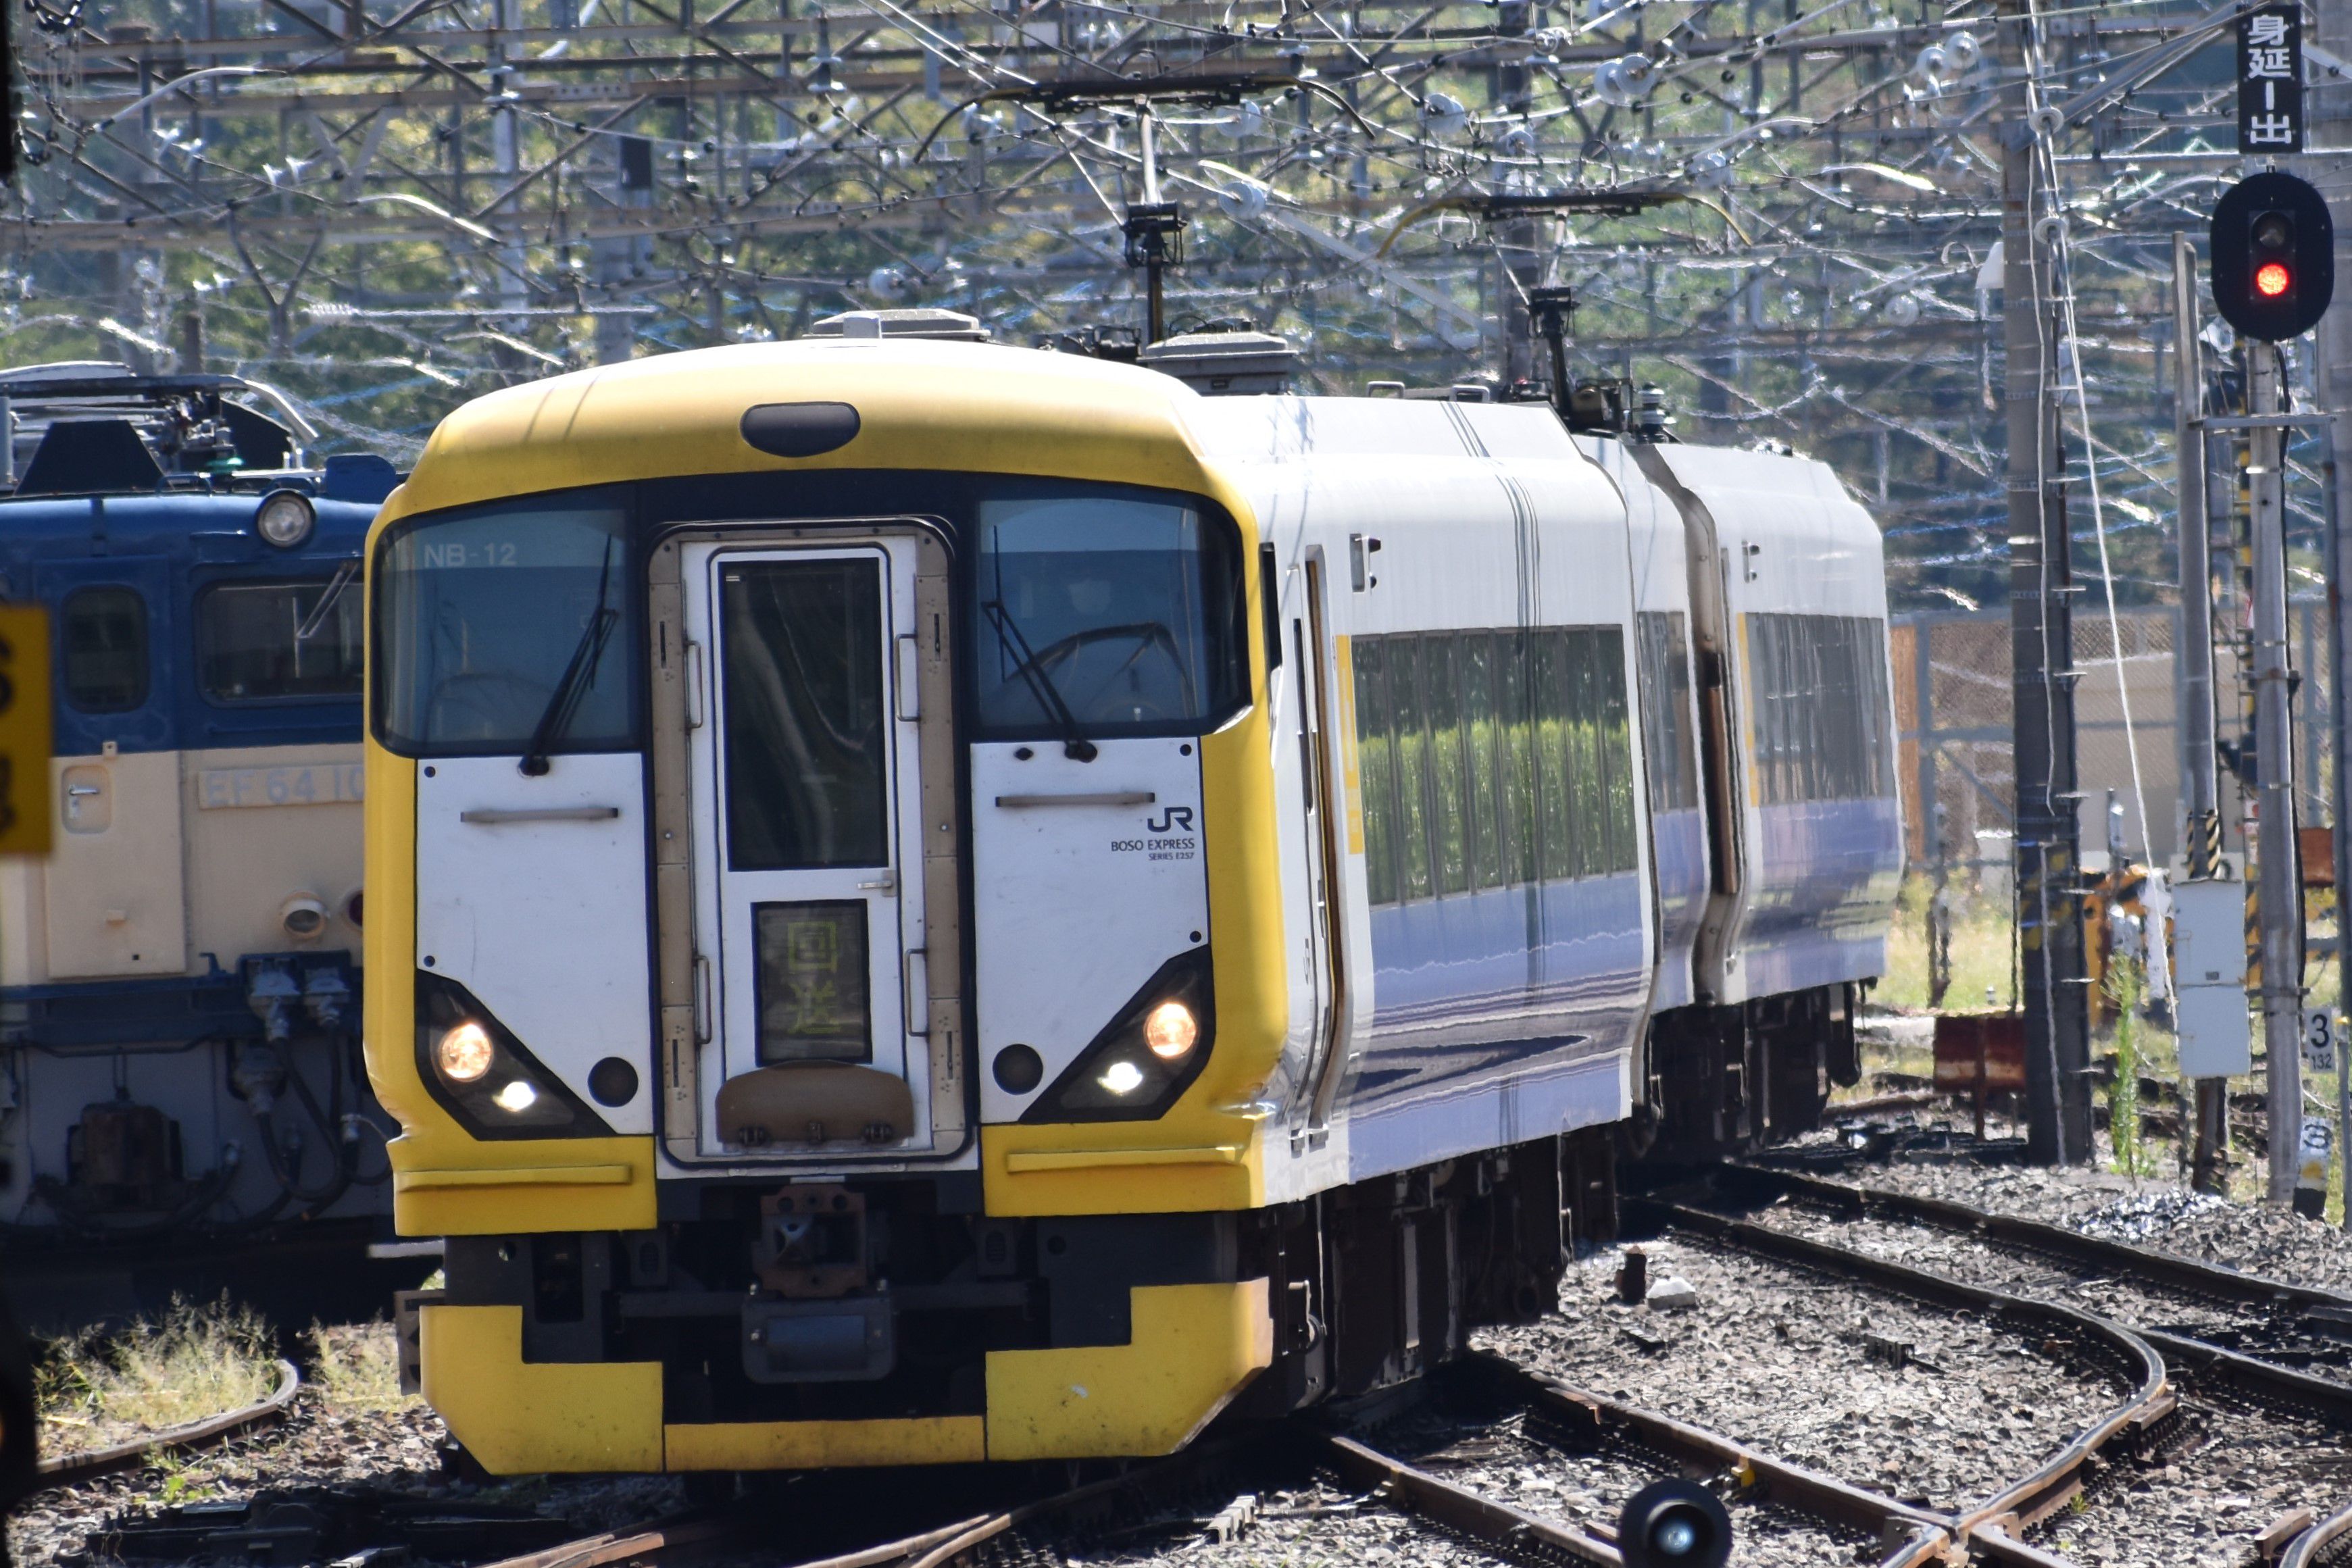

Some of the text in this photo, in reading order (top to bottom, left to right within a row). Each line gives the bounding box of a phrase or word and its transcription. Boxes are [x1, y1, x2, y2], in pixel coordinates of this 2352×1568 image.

[424, 542, 518, 568] NB-12
[205, 769, 254, 807] EF
[266, 768, 316, 804] 64
[1147, 807, 1194, 832] JR
[1111, 838, 1195, 852] BOSO EXPRESS
[1149, 852, 1195, 861] SERIES E257
[2310, 1013, 2330, 1048] 3
[2311, 1053, 2332, 1070] 132
